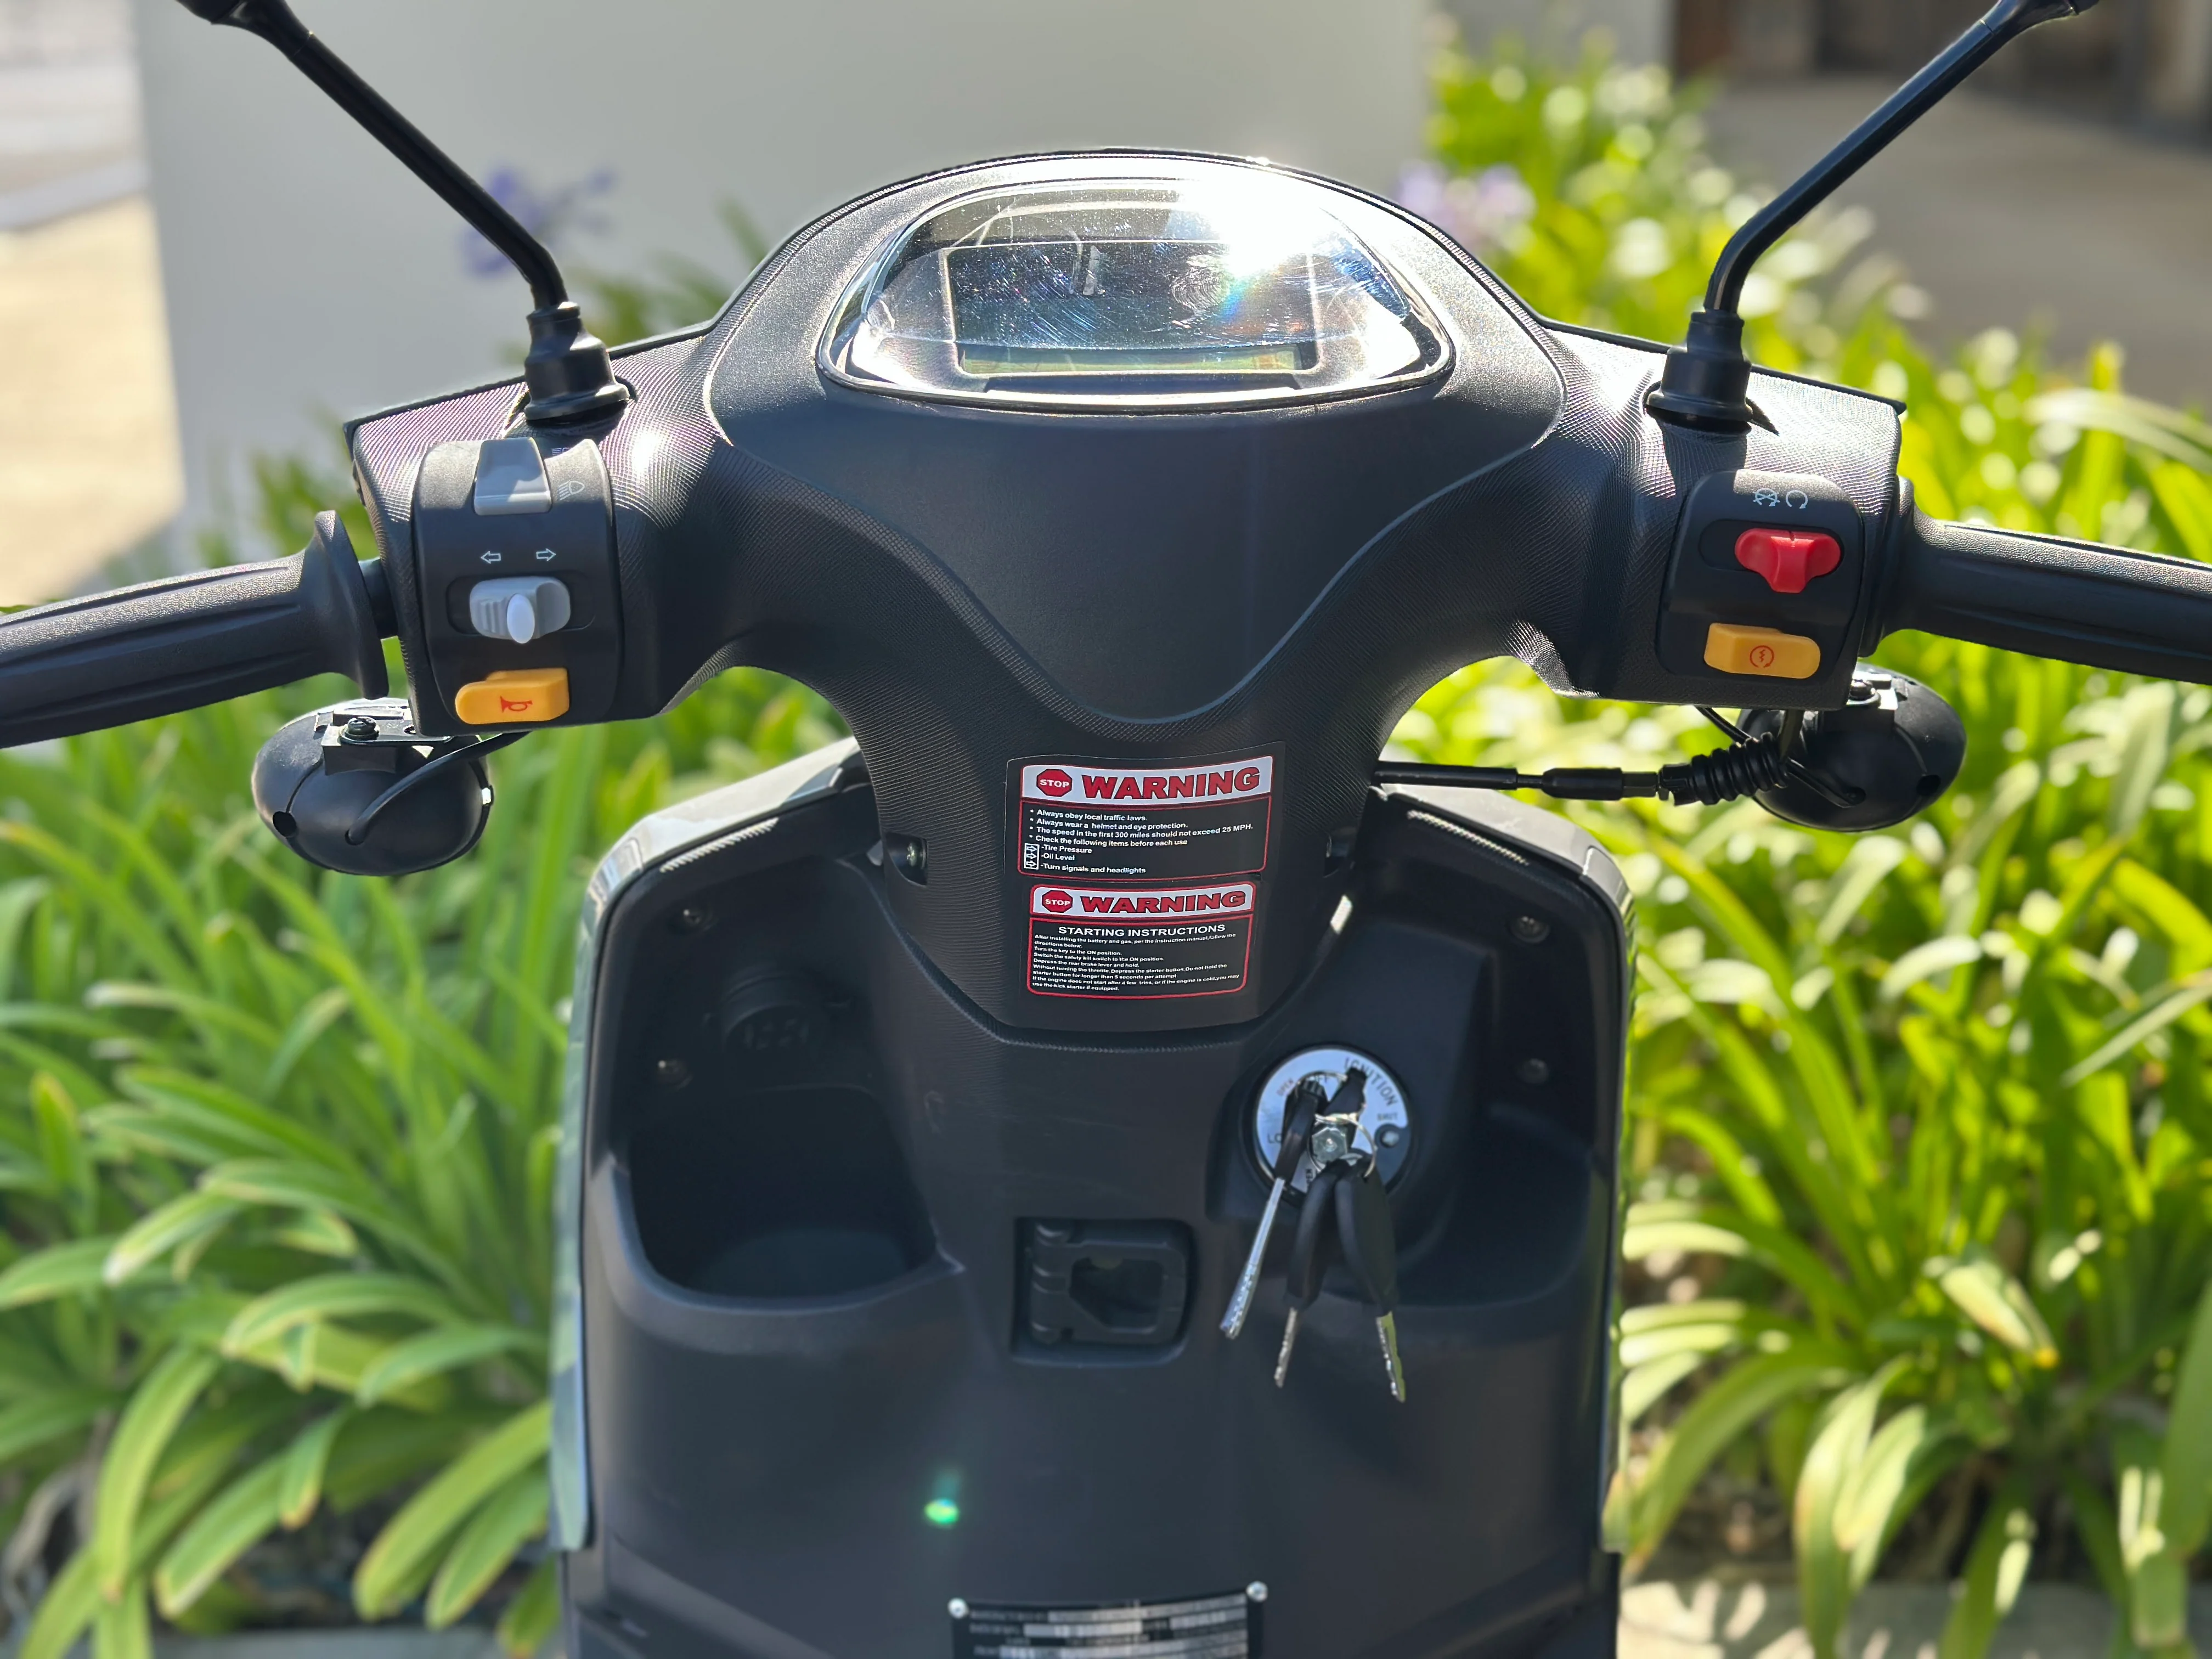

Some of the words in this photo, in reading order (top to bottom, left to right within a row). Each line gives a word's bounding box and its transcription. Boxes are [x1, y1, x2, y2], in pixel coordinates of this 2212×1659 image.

[1040, 779, 1069, 788] STOP
[1082, 766, 1260, 799] WARNING
[1037, 809, 1064, 818] Always
[1036, 818, 1063, 827] Always
[1233, 823, 1253, 832] MPH.
[1074, 838, 1107, 847] following
[1059, 845, 1092, 854] Pressure
[1081, 890, 1246, 913] WARNING
[1058, 927, 1125, 936] STARTING
[1128, 924, 1225, 936] INSTRUCTIONS
